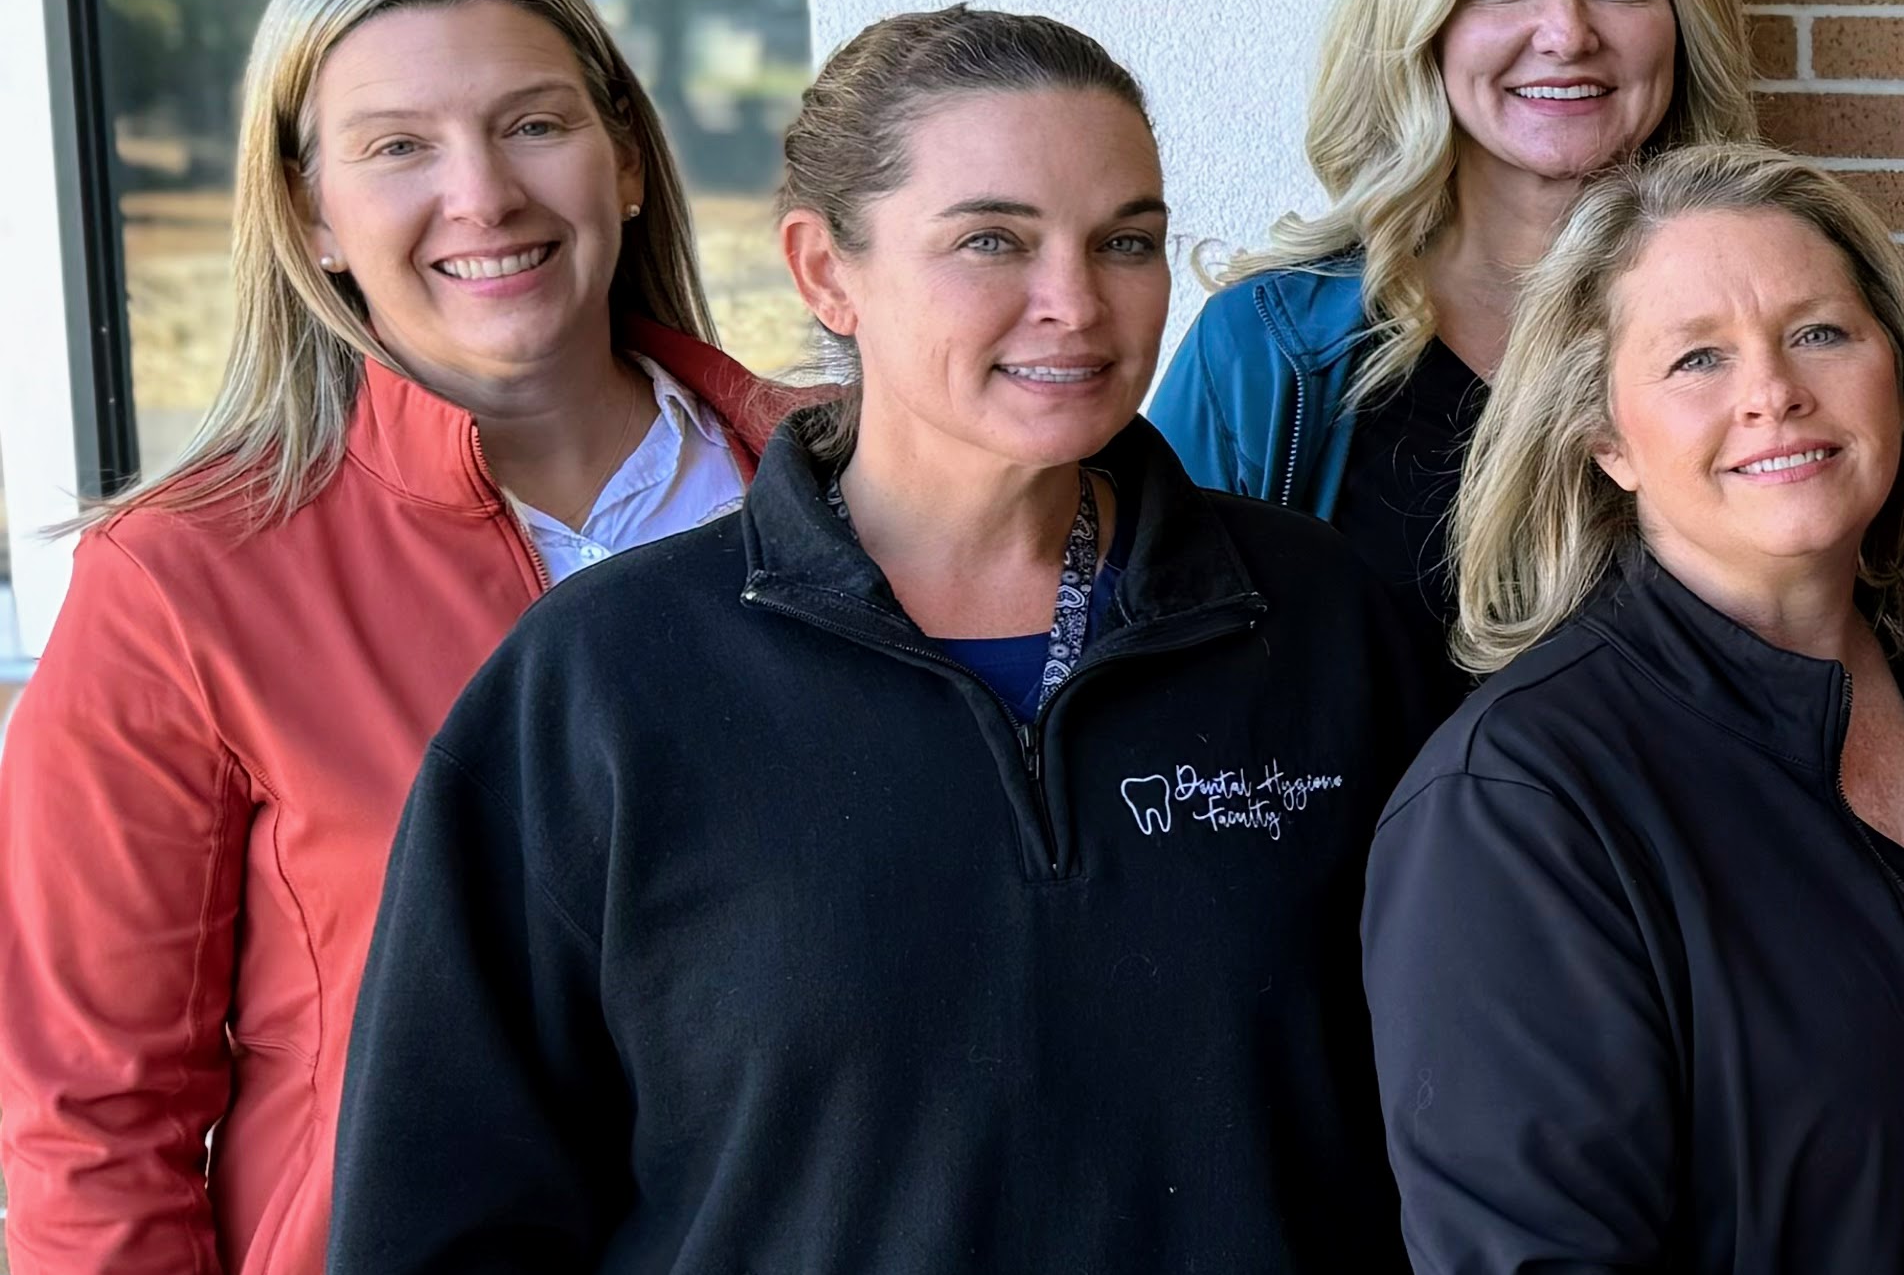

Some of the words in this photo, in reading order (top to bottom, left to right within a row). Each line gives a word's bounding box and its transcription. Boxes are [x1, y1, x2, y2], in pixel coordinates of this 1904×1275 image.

[1175, 764, 1251, 801] Dental
[1256, 757, 1342, 810] Hygiene
[1192, 795, 1281, 840] Faculty
